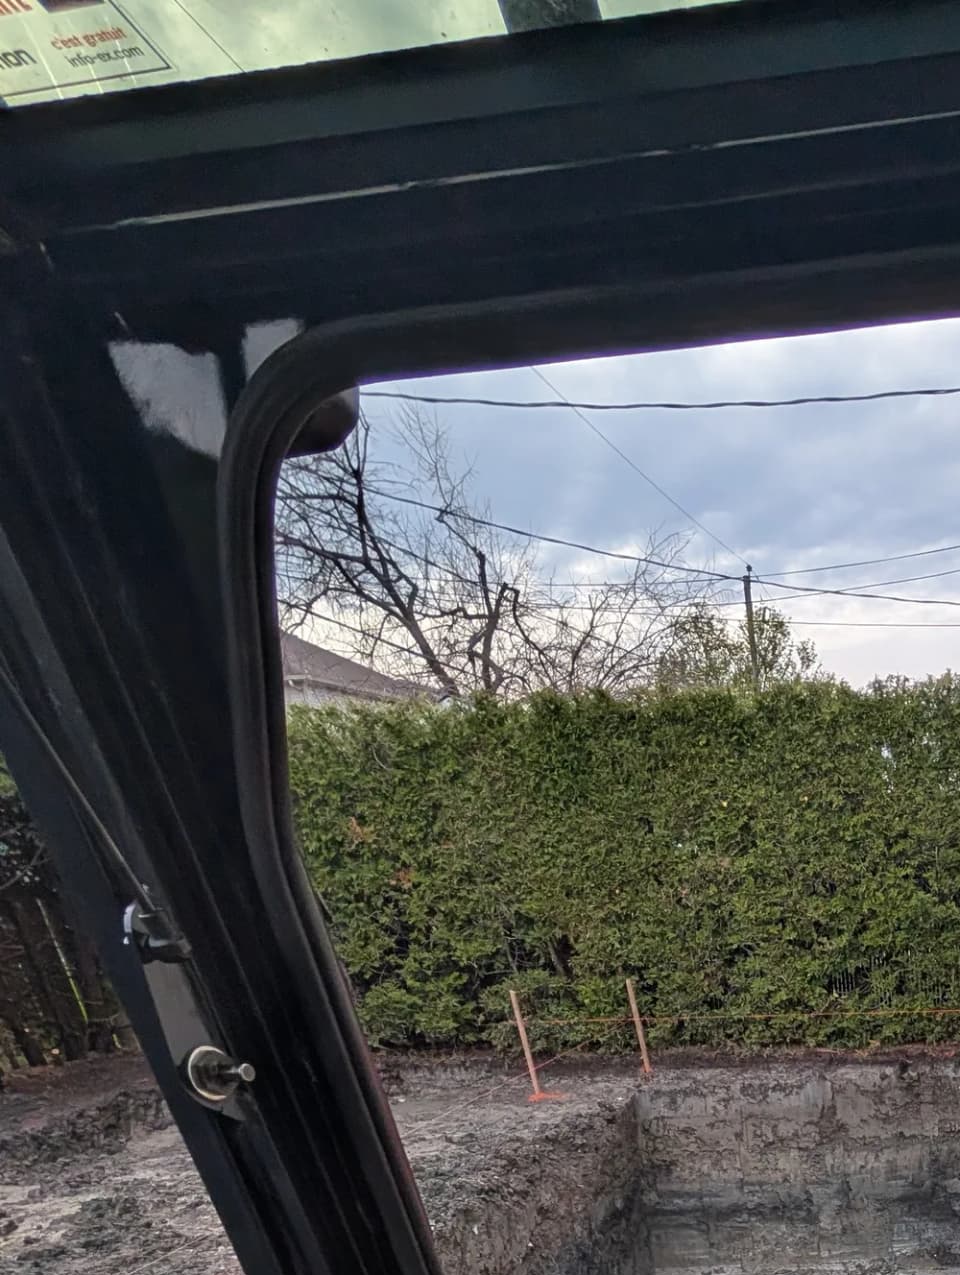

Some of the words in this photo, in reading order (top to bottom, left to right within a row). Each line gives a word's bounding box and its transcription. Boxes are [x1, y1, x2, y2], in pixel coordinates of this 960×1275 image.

[82, 27, 127, 48] gratuit
[0, 48, 37, 70] ion
[64, 46, 145, 68] info-ex.com
